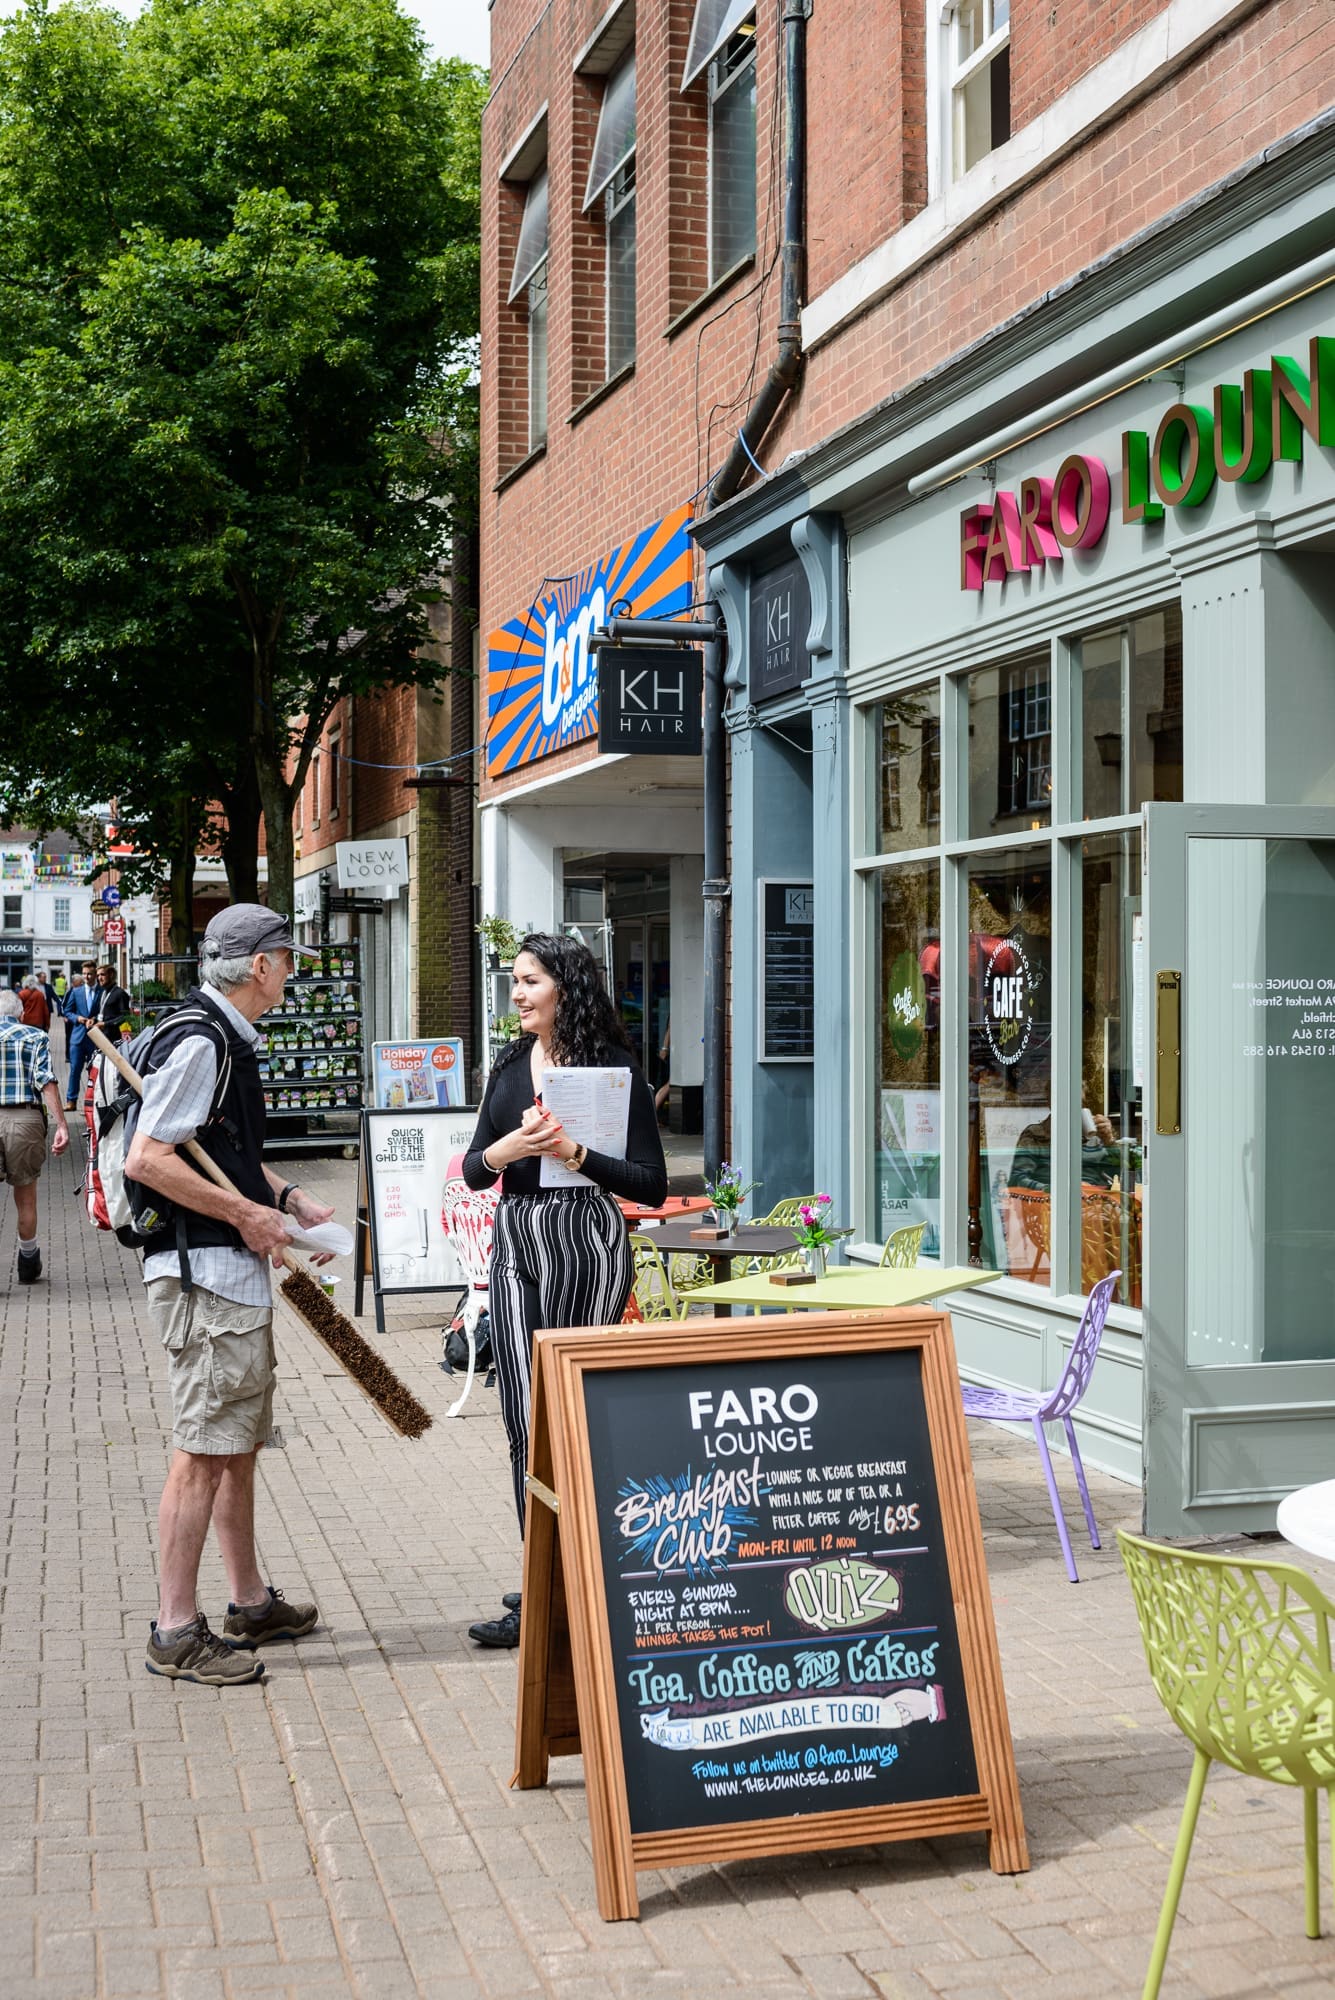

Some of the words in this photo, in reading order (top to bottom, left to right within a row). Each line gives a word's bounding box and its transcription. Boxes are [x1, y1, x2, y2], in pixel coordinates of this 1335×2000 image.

[960, 454, 1112, 592] FARO
[1122, 336, 1335, 526] LOUN
[767, 591, 791, 646] KH
[542, 586, 605, 726] b&m
[766, 647, 790, 670] HAIR
[620, 669, 684, 711] KH
[620, 718, 684, 733] HAIR
[349, 850, 394, 863] NEW
[346, 863, 400, 878] LOOK
[2, 944, 29, 953] LOCAL
[992, 966, 1023, 1018] CAFÉ
[998, 1018, 1020, 1045] Bar
[381, 1047, 428, 1060] Holiday
[391, 1059, 422, 1071] Shop
[432, 1053, 455, 1064] £1.49
[387, 1136, 424, 1145] SWEETIE
[391, 1128, 424, 1137] QUICK
[375, 1153, 398, 1162] GHD
[408, 1145, 425, 1153] THE
[688, 1383, 819, 1430] FARO
[704, 1426, 814, 1458] LOUNGE
[766, 1469, 803, 1486] LOUNGE
[807, 1467, 821, 1482] OR
[822, 1463, 855, 1481] VEGGIE
[856, 1460, 908, 1478] BREAKFAST
[614, 1456, 765, 1537] Breakfast
[768, 1491, 792, 1508] WITH
[794, 1490, 801, 1506] A
[802, 1489, 824, 1505] NICE
[827, 1487, 843, 1503] CUP
[845, 1486, 856, 1501] OF
[858, 1484, 877, 1500] TEA
[878, 1483, 893, 1498] OR
[896, 1482, 903, 1497] A
[772, 1513, 805, 1530] FILTER
[808, 1511, 841, 1528] COFFEE
[653, 1510, 732, 1570] Club
[738, 1536, 790, 1558] MON-FRI
[792, 1535, 817, 1553] UNTIL
[821, 1533, 833, 1550] 12
[836, 1537, 857, 1549] NOON
[627, 1588, 676, 1607] EVERY
[682, 1582, 738, 1602] SUNDAY
[634, 1606, 675, 1623] NIGHT
[680, 1602, 696, 1619] AT
[634, 1632, 681, 1648] WINNER
[682, 1629, 717, 1644] TAKES
[719, 1626, 739, 1640] THE
[655, 1619, 673, 1634] PER
[628, 1660, 694, 1706] Tea,
[698, 1652, 792, 1699] Coffee
[796, 1649, 841, 1689] AND
[847, 1634, 940, 1684] Cakes
[703, 1719, 734, 1743] ARE
[739, 1704, 822, 1737] AVAILABLE
[826, 1703, 848, 1723] TO
[852, 1704, 881, 1724] GO!
[691, 1760, 730, 1780] Follow
[733, 1763, 747, 1776] us
[749, 1761, 760, 1775] on
[761, 1750, 801, 1772] twitter
[704, 1764, 877, 1799] WWW.THELOUNGES.CO.UK
